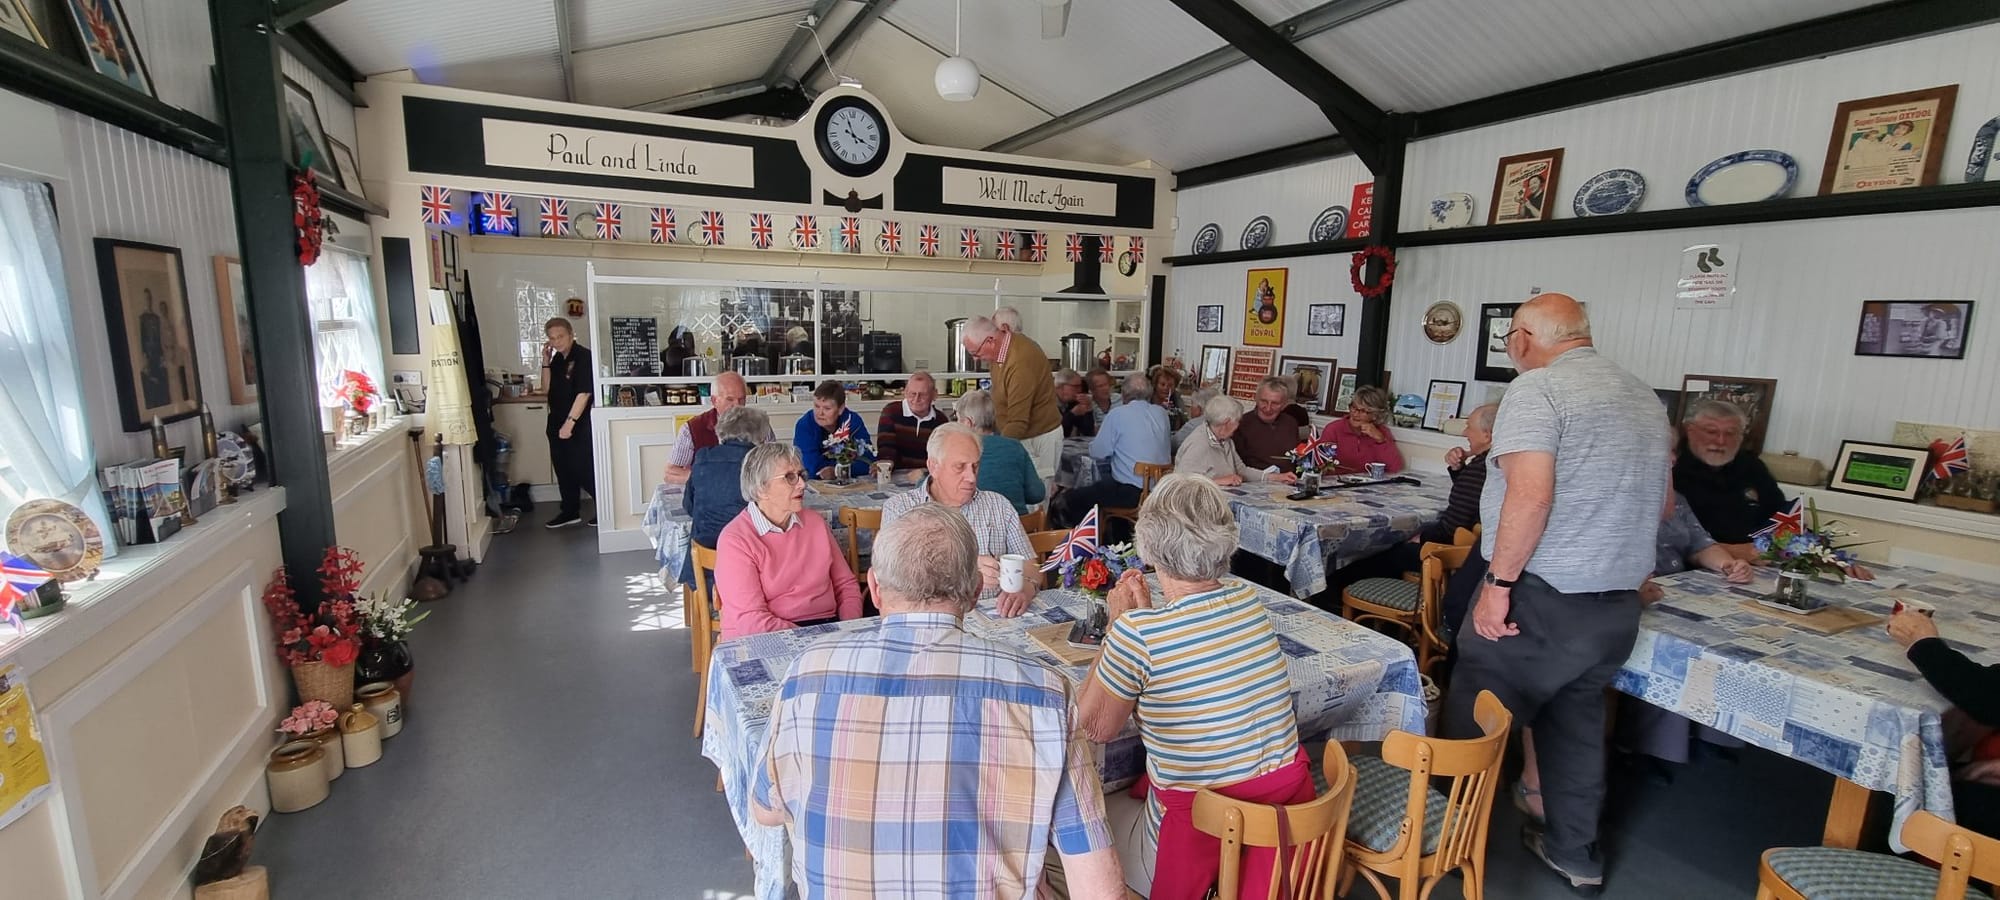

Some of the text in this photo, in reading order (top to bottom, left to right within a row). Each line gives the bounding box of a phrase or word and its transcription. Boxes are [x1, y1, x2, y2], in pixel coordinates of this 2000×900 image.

[547, 133, 698, 176] Paul and Linda
[1012, 179, 1048, 204] Meet
[1048, 183, 1084, 211] Again
[1360, 196, 1373, 205] KE
[1352, 220, 1370, 229] CAR
[1250, 328, 1275, 338] BOVRIL
[431, 358, 459, 367] RATION
